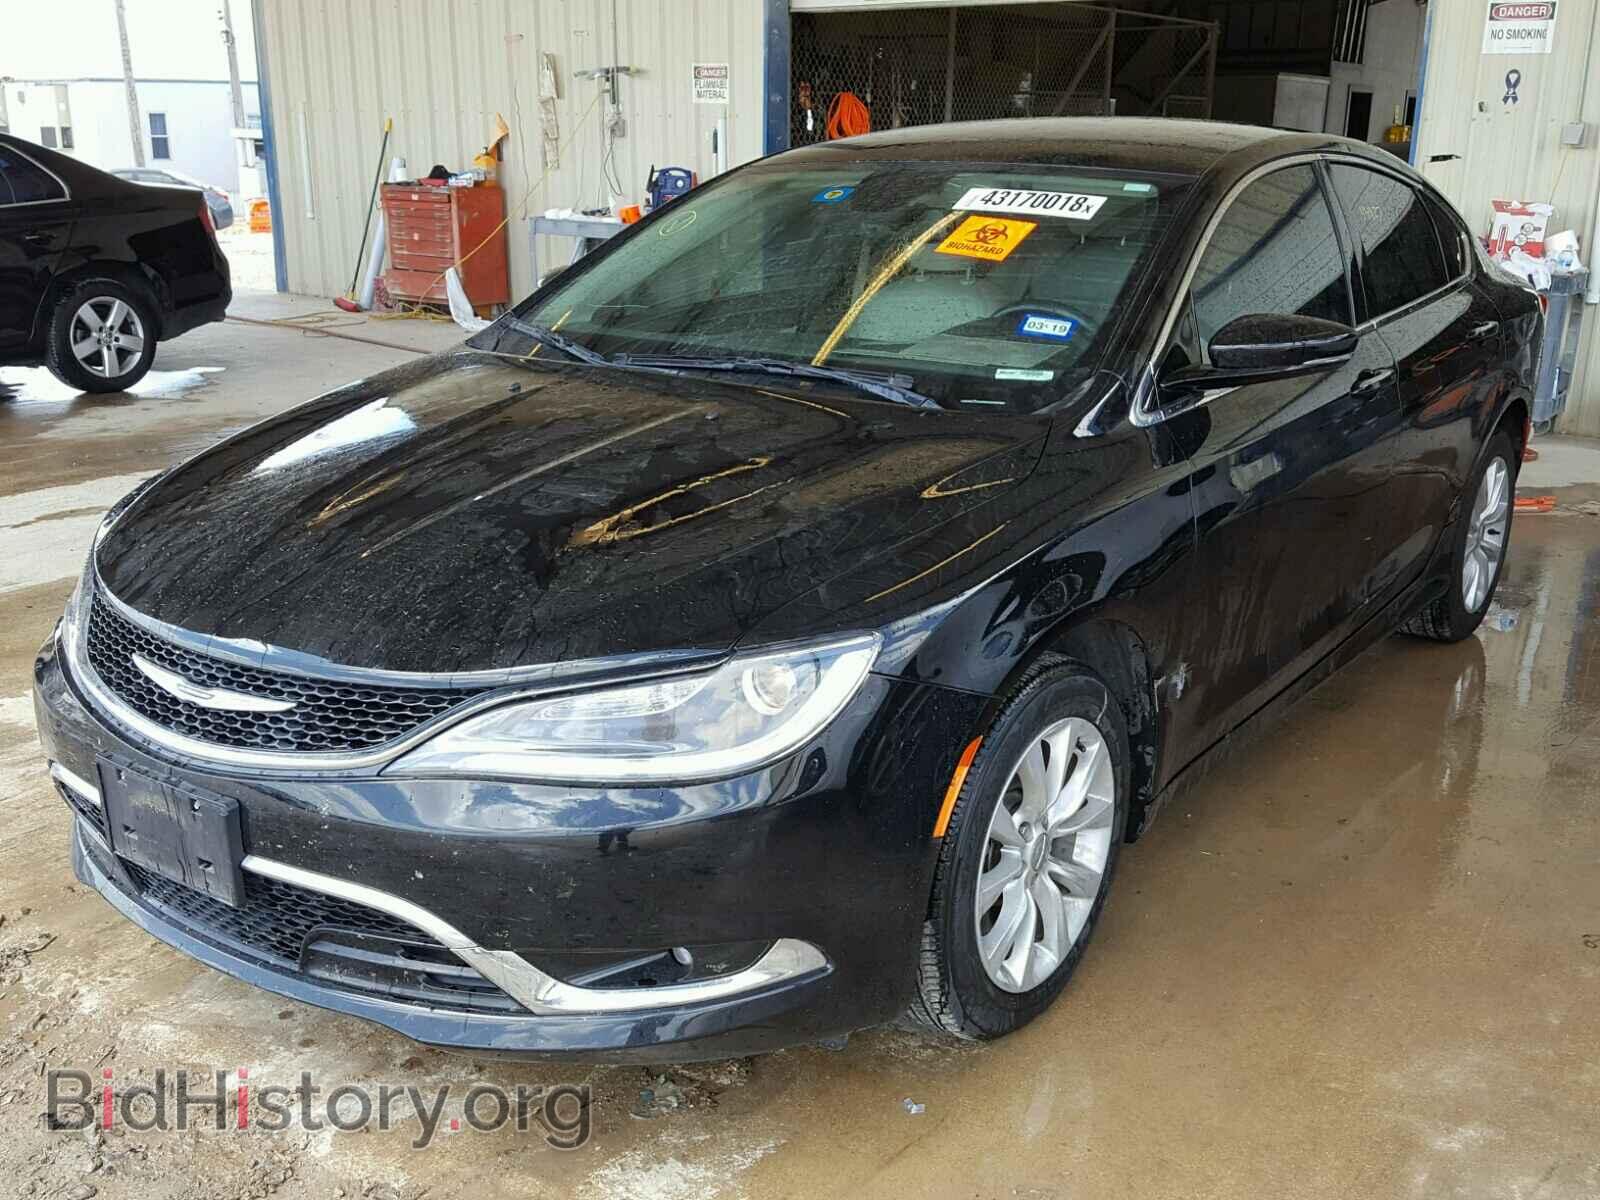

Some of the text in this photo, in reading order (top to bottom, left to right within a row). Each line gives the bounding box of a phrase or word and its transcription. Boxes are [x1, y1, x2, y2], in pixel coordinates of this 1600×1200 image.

[1499, 5, 1547, 17] DANGER
[1490, 28, 1548, 40] NO SMOKING
[946, 241, 1005, 255] BIOHAZARD
